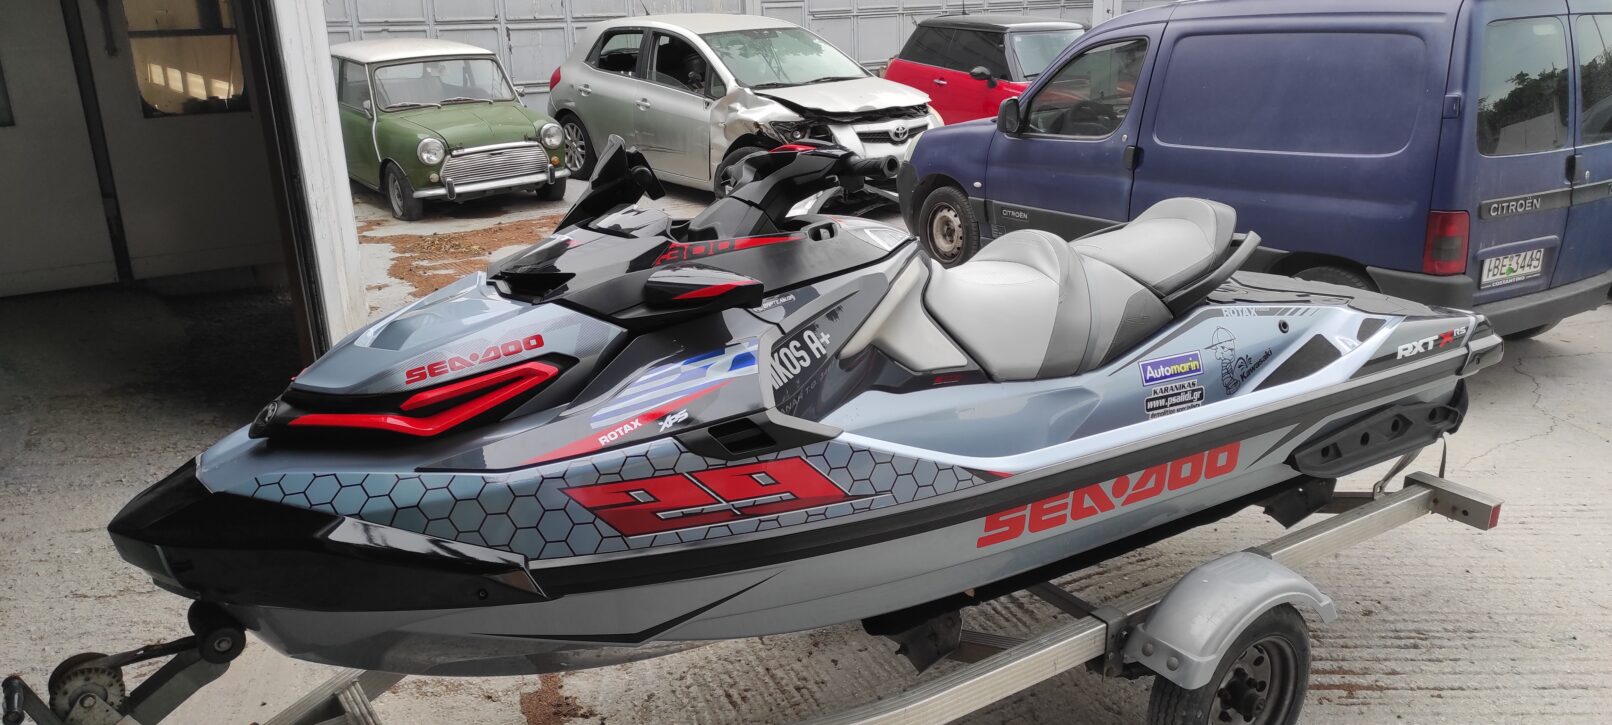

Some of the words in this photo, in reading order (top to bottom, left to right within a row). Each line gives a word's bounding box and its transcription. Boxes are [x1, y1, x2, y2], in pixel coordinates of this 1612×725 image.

[1490, 196, 1541, 216] CITROËN
[1222, 307, 1257, 317] ROTAX
[1145, 357, 1201, 380] Automarin
[1240, 348, 1273, 382] Kawasaki
[1147, 389, 1202, 409] www.psalidi.gr
[1153, 381, 1197, 396] KARANIKAS
[598, 418, 643, 446] ROTAX
[657, 408, 689, 432] XPS
[557, 456, 852, 538] 29
